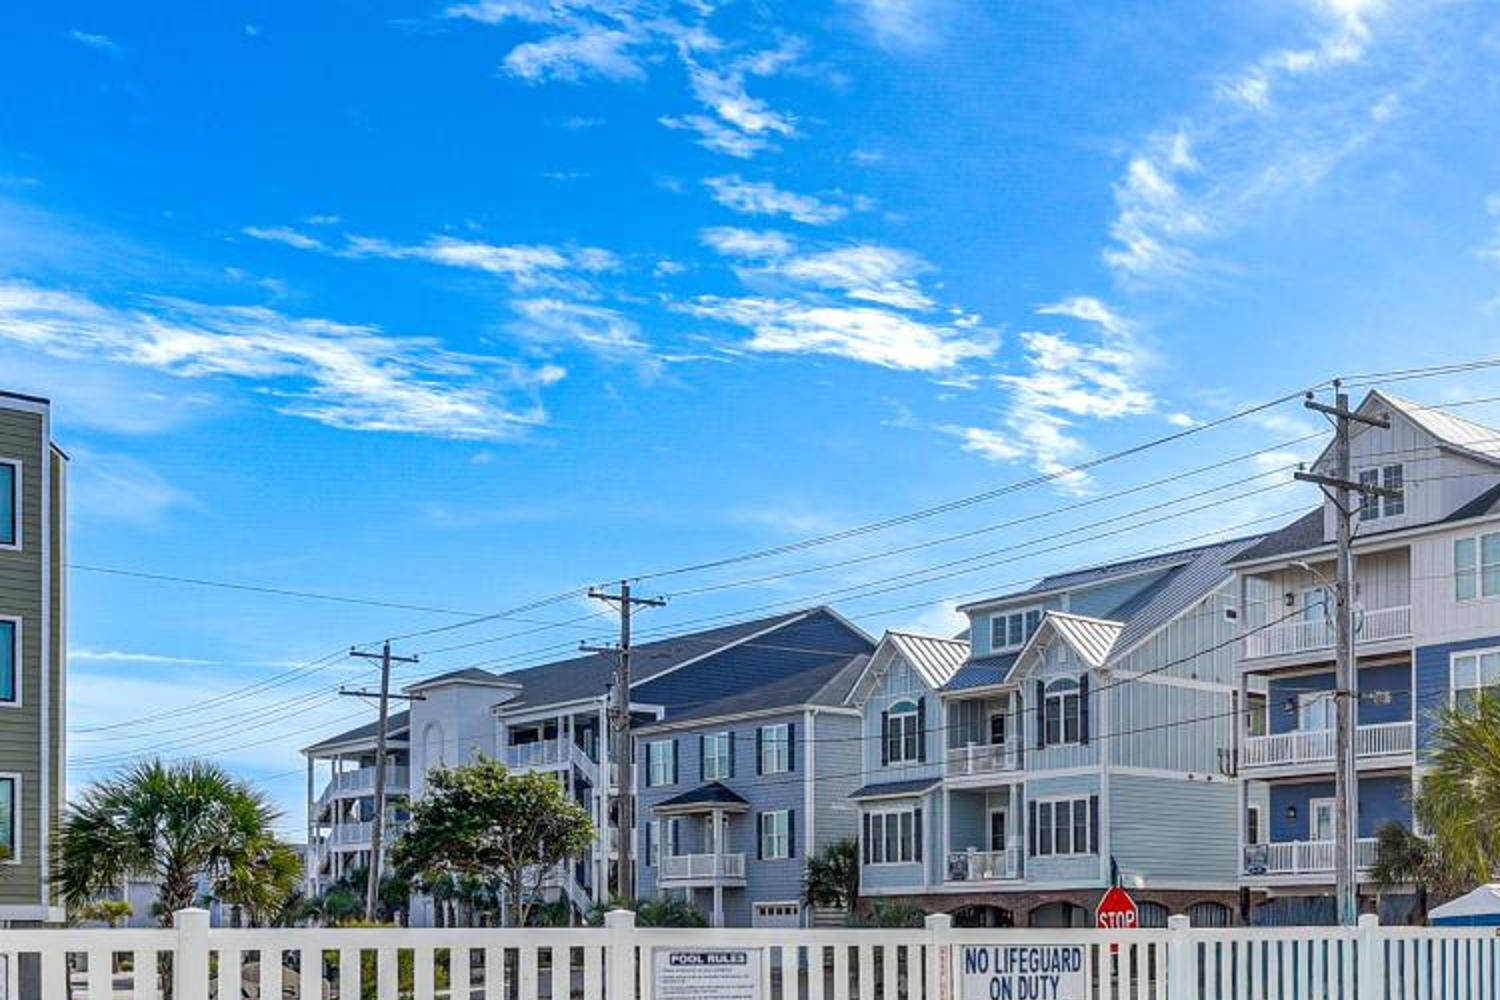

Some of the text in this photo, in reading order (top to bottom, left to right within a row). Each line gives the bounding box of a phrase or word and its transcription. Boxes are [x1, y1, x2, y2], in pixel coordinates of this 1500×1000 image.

[1099, 911, 1135, 929] STOP
[671, 953, 745, 964] POOL RULES
[965, 947, 1082, 974] NO LIFEGUARD
[1018, 975, 1059, 1000] DUTY
